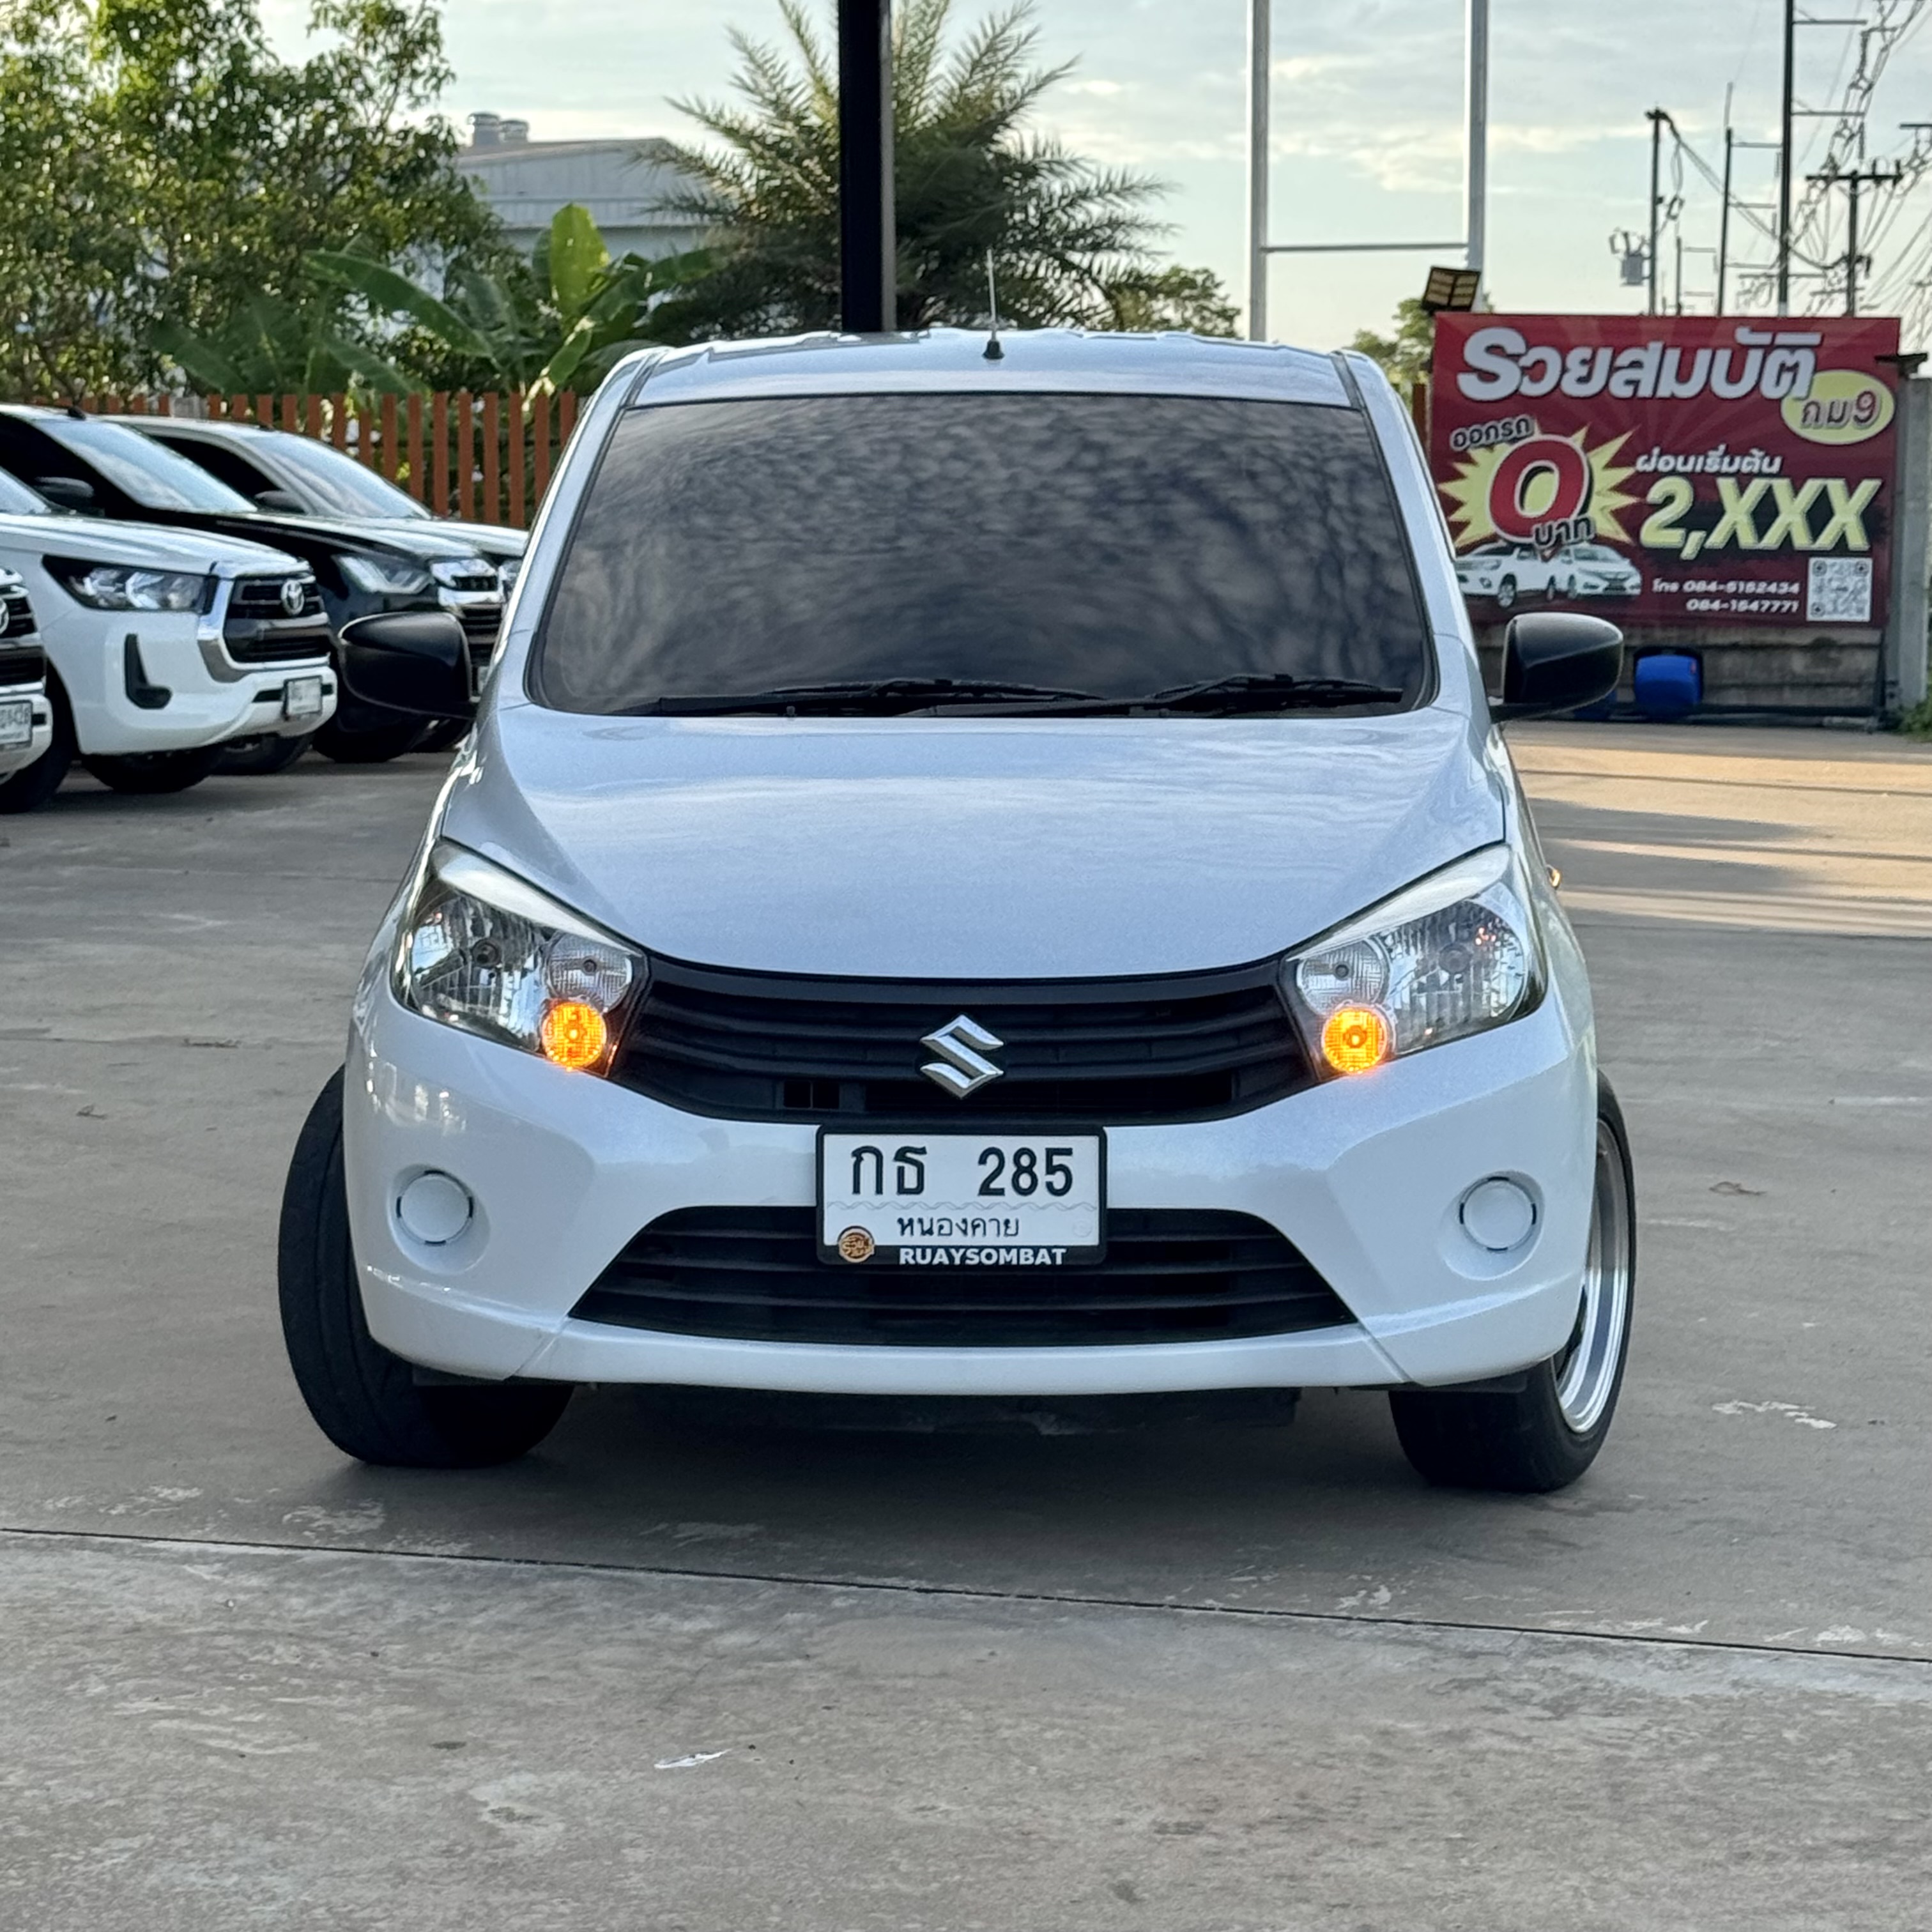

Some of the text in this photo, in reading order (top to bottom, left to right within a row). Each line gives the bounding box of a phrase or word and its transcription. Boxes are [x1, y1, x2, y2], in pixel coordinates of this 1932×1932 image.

[1457, 326, 1822, 401] รวยสมบัติ
[1486, 436, 1590, 542] 0
[1533, 516, 1592, 547] บาท
[1640, 475, 1883, 560] 2,XXX
[851, 1146, 1073, 1197] กธ 285
[897, 1216, 1020, 1238] หนองคาย
[899, 1248, 1066, 1265] RUAYSOMBAT
